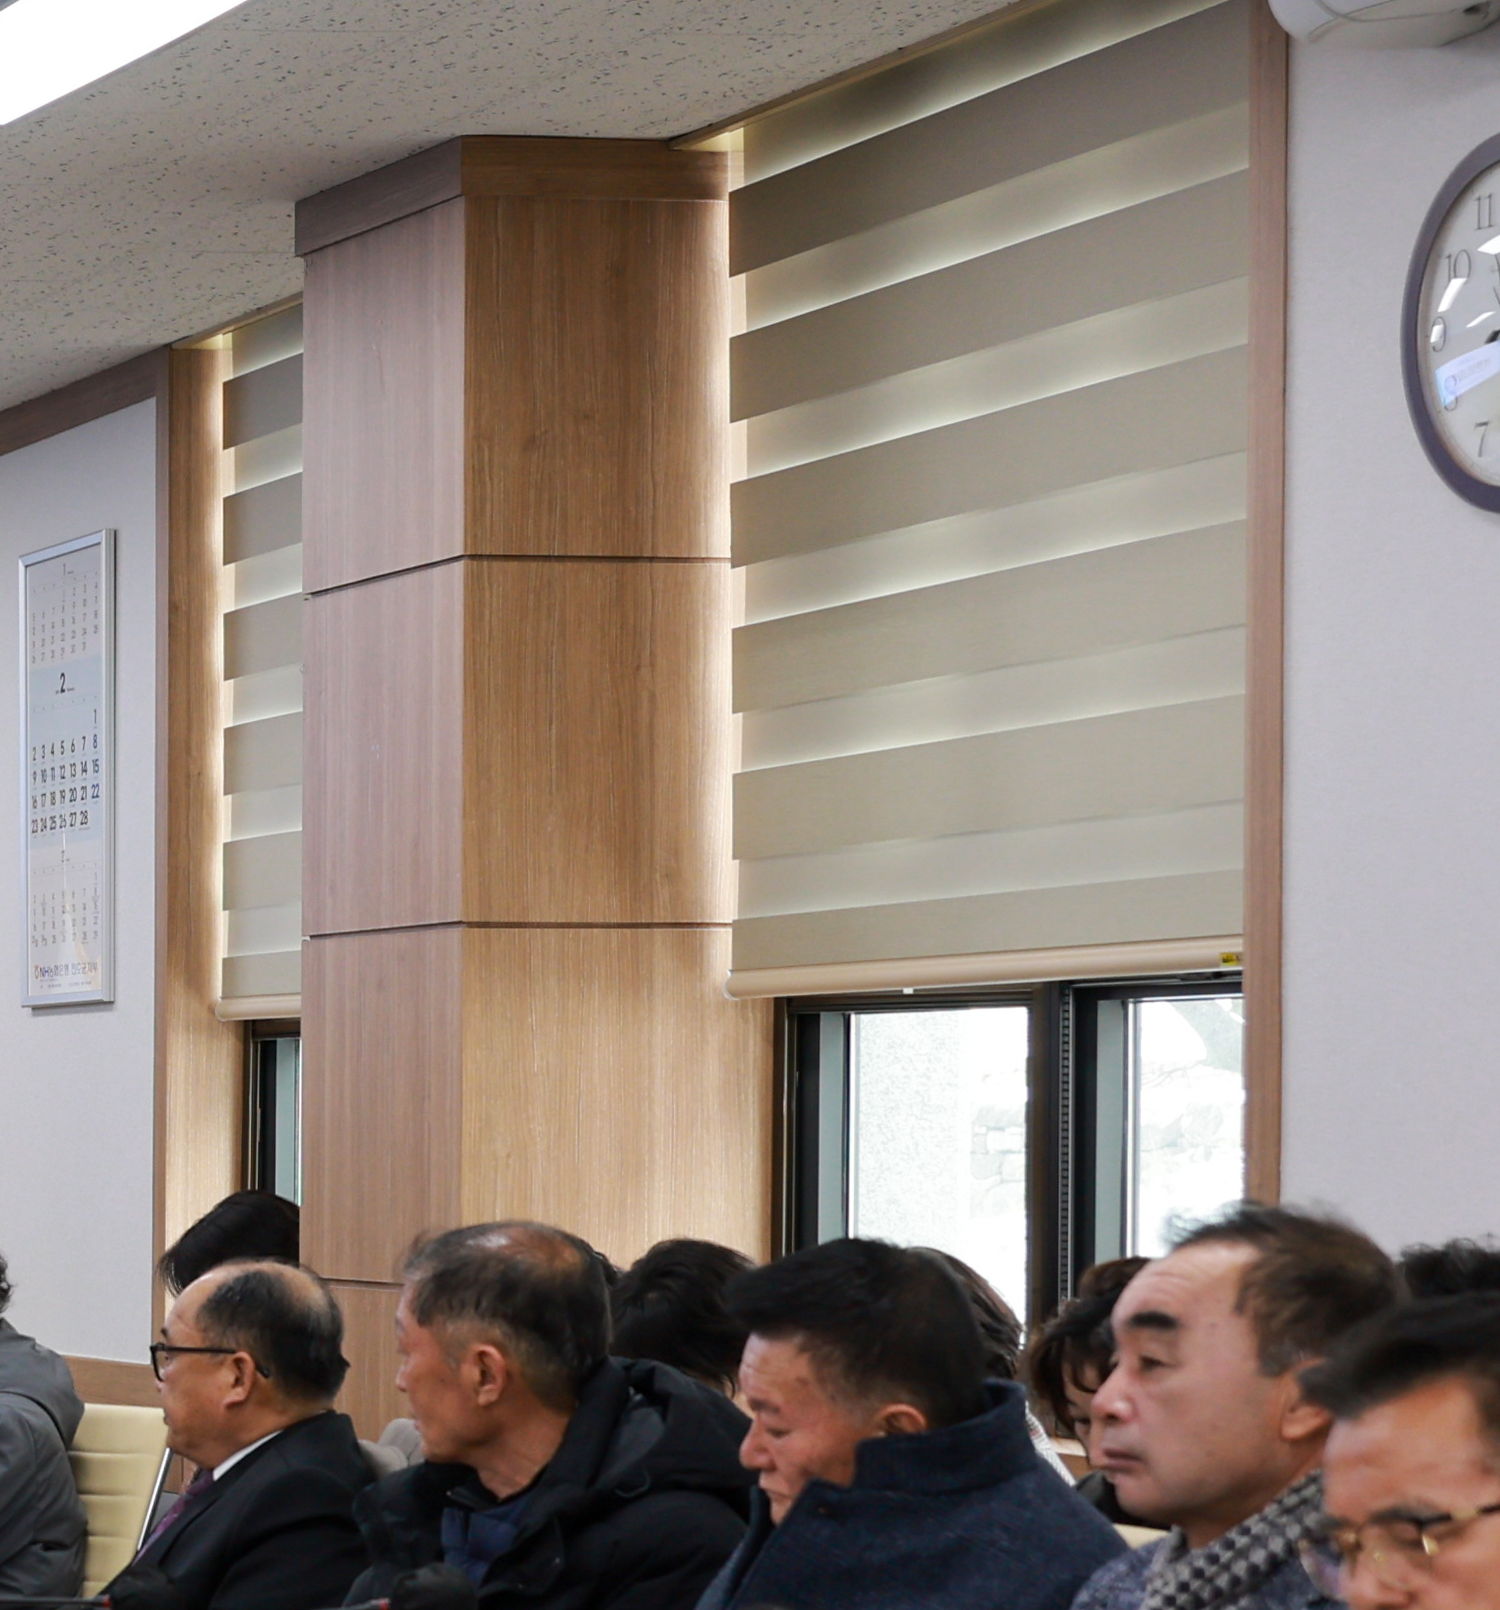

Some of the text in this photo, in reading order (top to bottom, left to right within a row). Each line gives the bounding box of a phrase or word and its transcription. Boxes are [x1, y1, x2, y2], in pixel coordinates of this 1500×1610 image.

[1475, 193, 1493, 231] 11
[1431, 316, 1446, 352] 9
[1474, 421, 1490, 458] 7
[60, 672, 66, 693] 2
